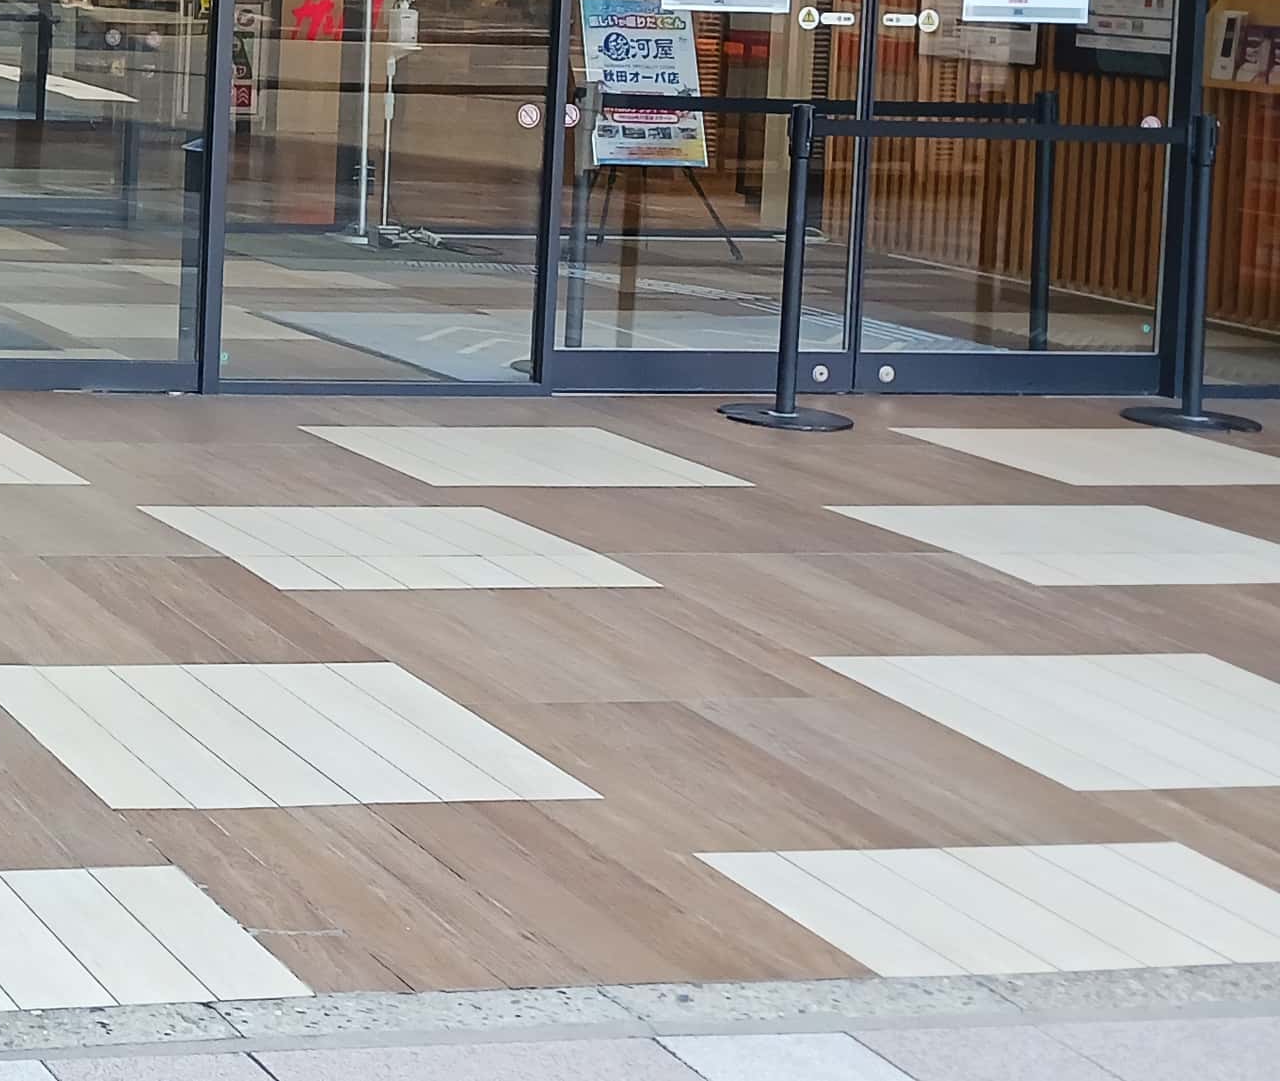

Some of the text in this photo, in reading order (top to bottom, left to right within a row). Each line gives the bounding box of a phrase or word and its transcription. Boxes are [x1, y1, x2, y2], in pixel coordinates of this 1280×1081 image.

[603, 70, 680, 84] 秋田オーパ店
